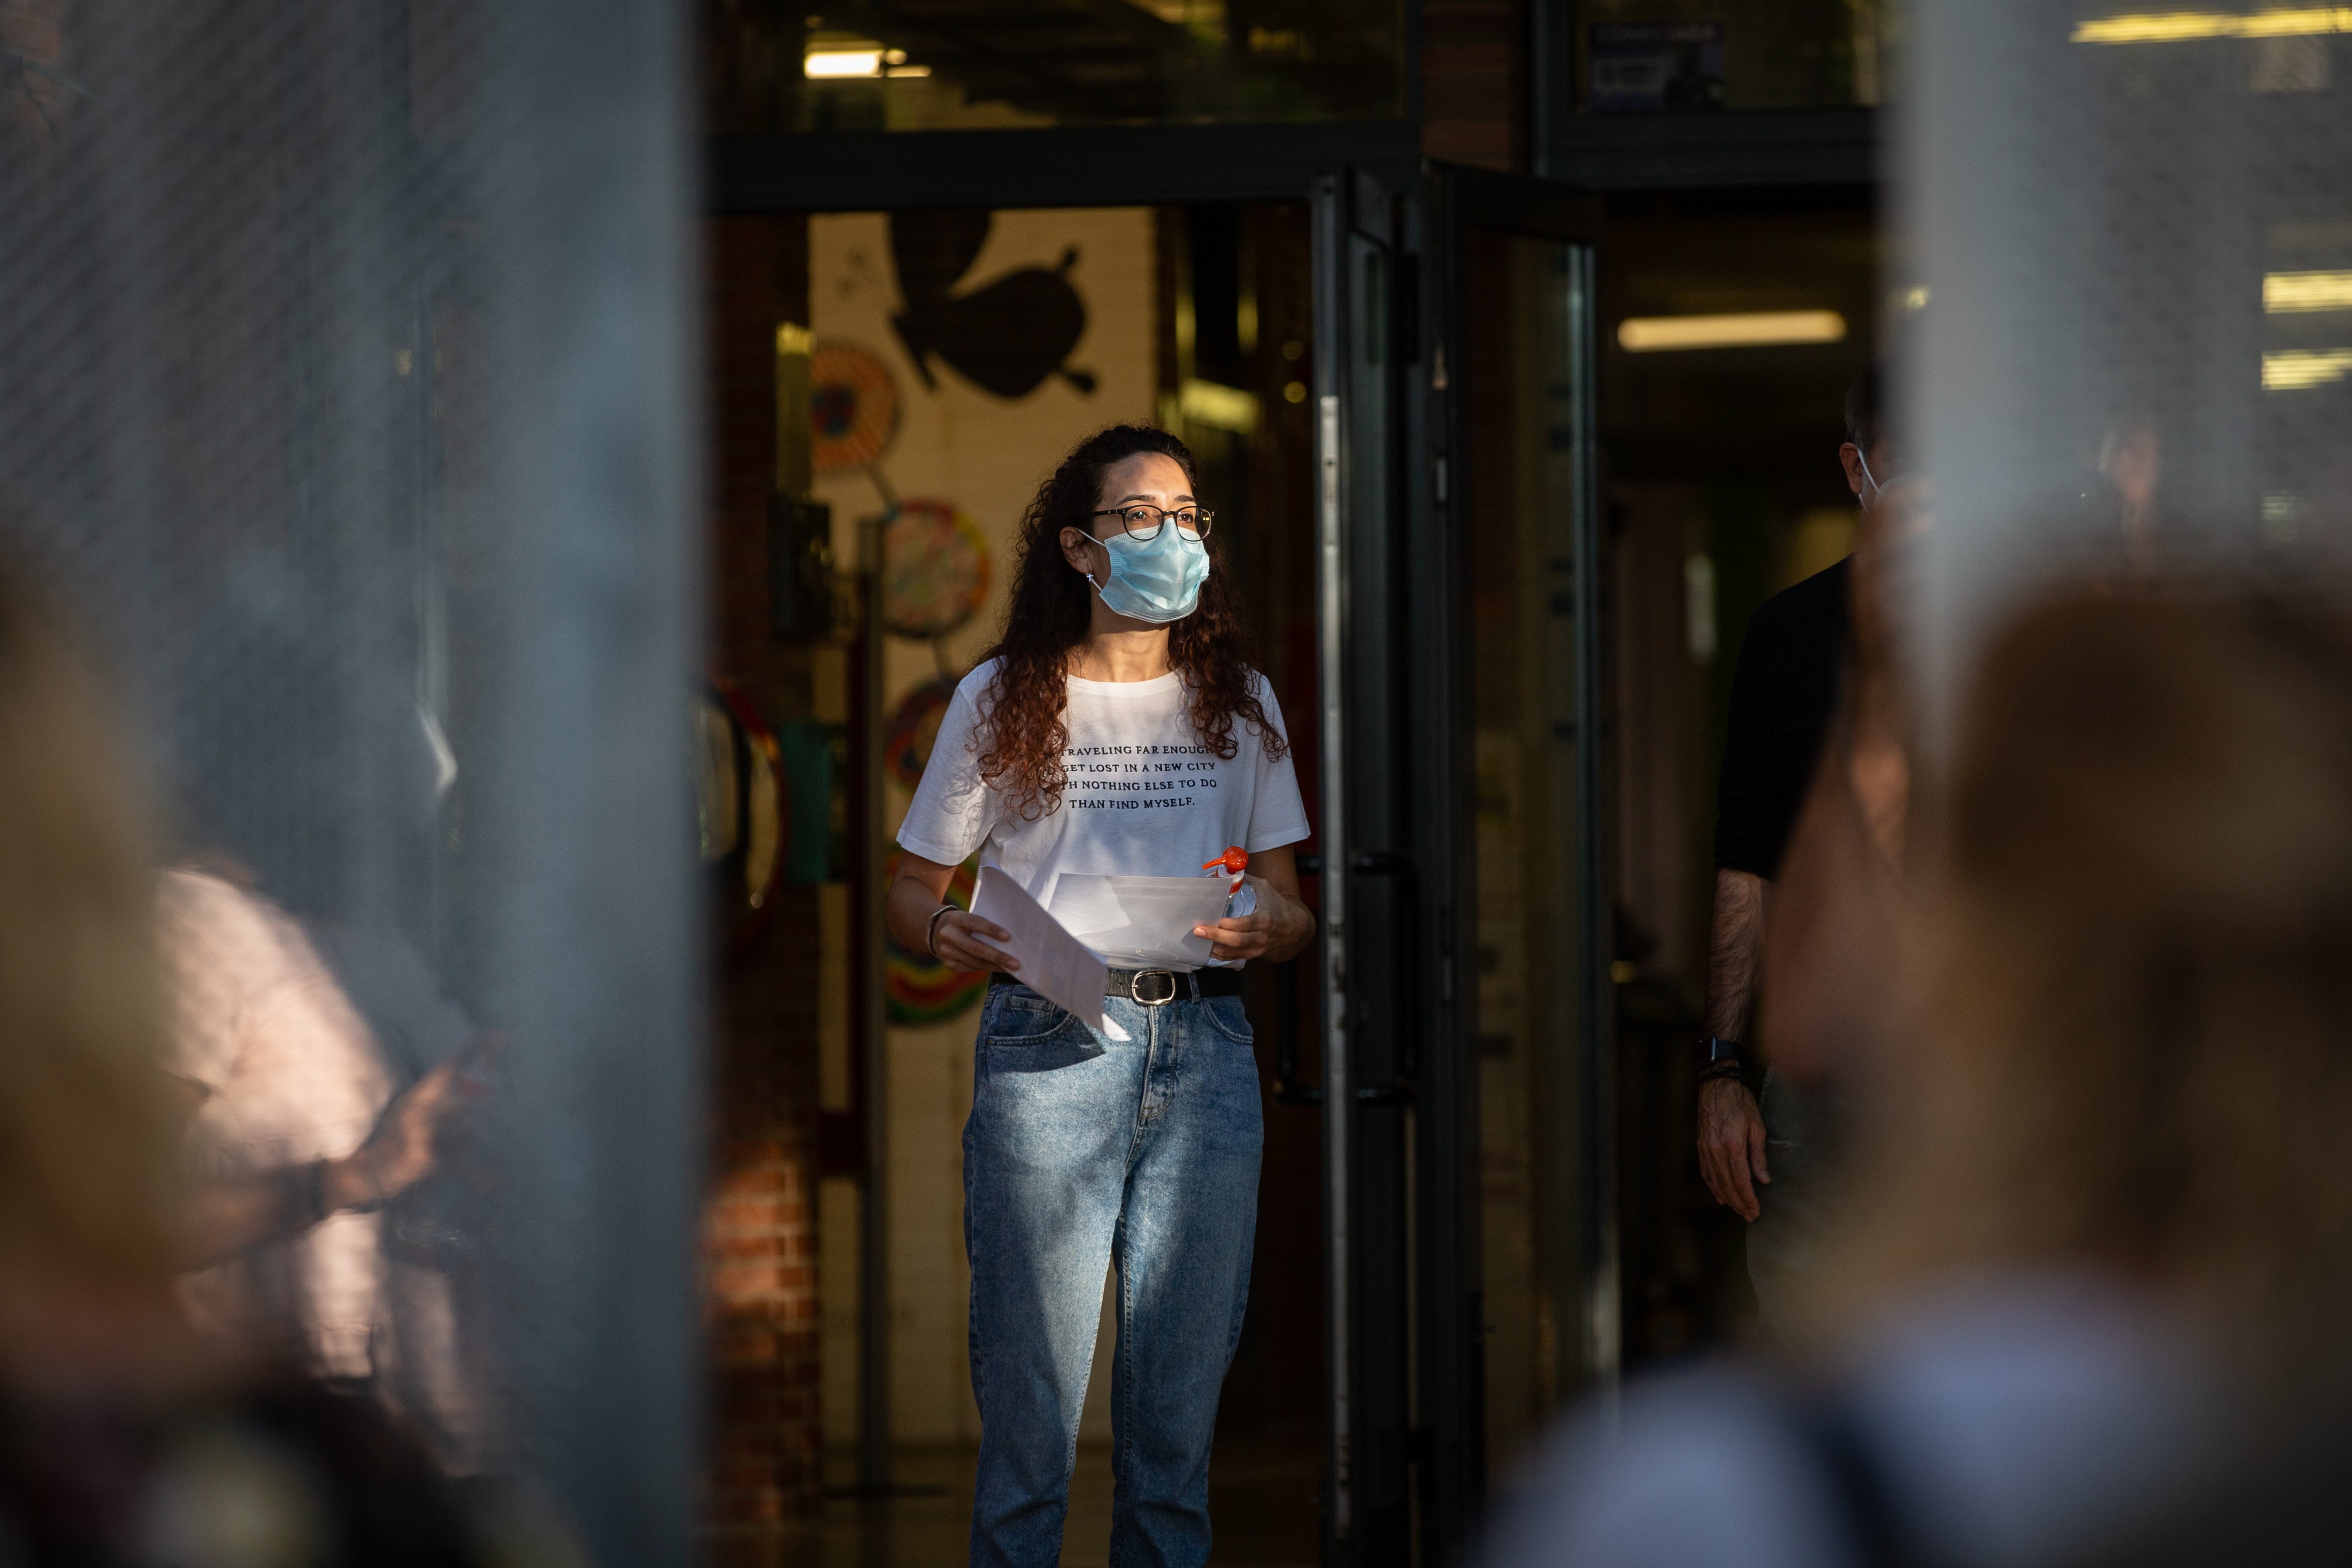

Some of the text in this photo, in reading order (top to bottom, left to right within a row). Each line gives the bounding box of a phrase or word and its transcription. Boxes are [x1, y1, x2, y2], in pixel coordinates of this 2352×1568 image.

[1062, 747, 1131, 756] TRAVELING
[1142, 764, 1150, 772] A
[1155, 763, 1182, 772] NEW
[1082, 781, 1140, 791] NOTHING
[1144, 781, 1174, 790] ELSE
[1200, 779, 1217, 787] DO
[1069, 797, 1195, 809] THAN FIND MYSELF.
